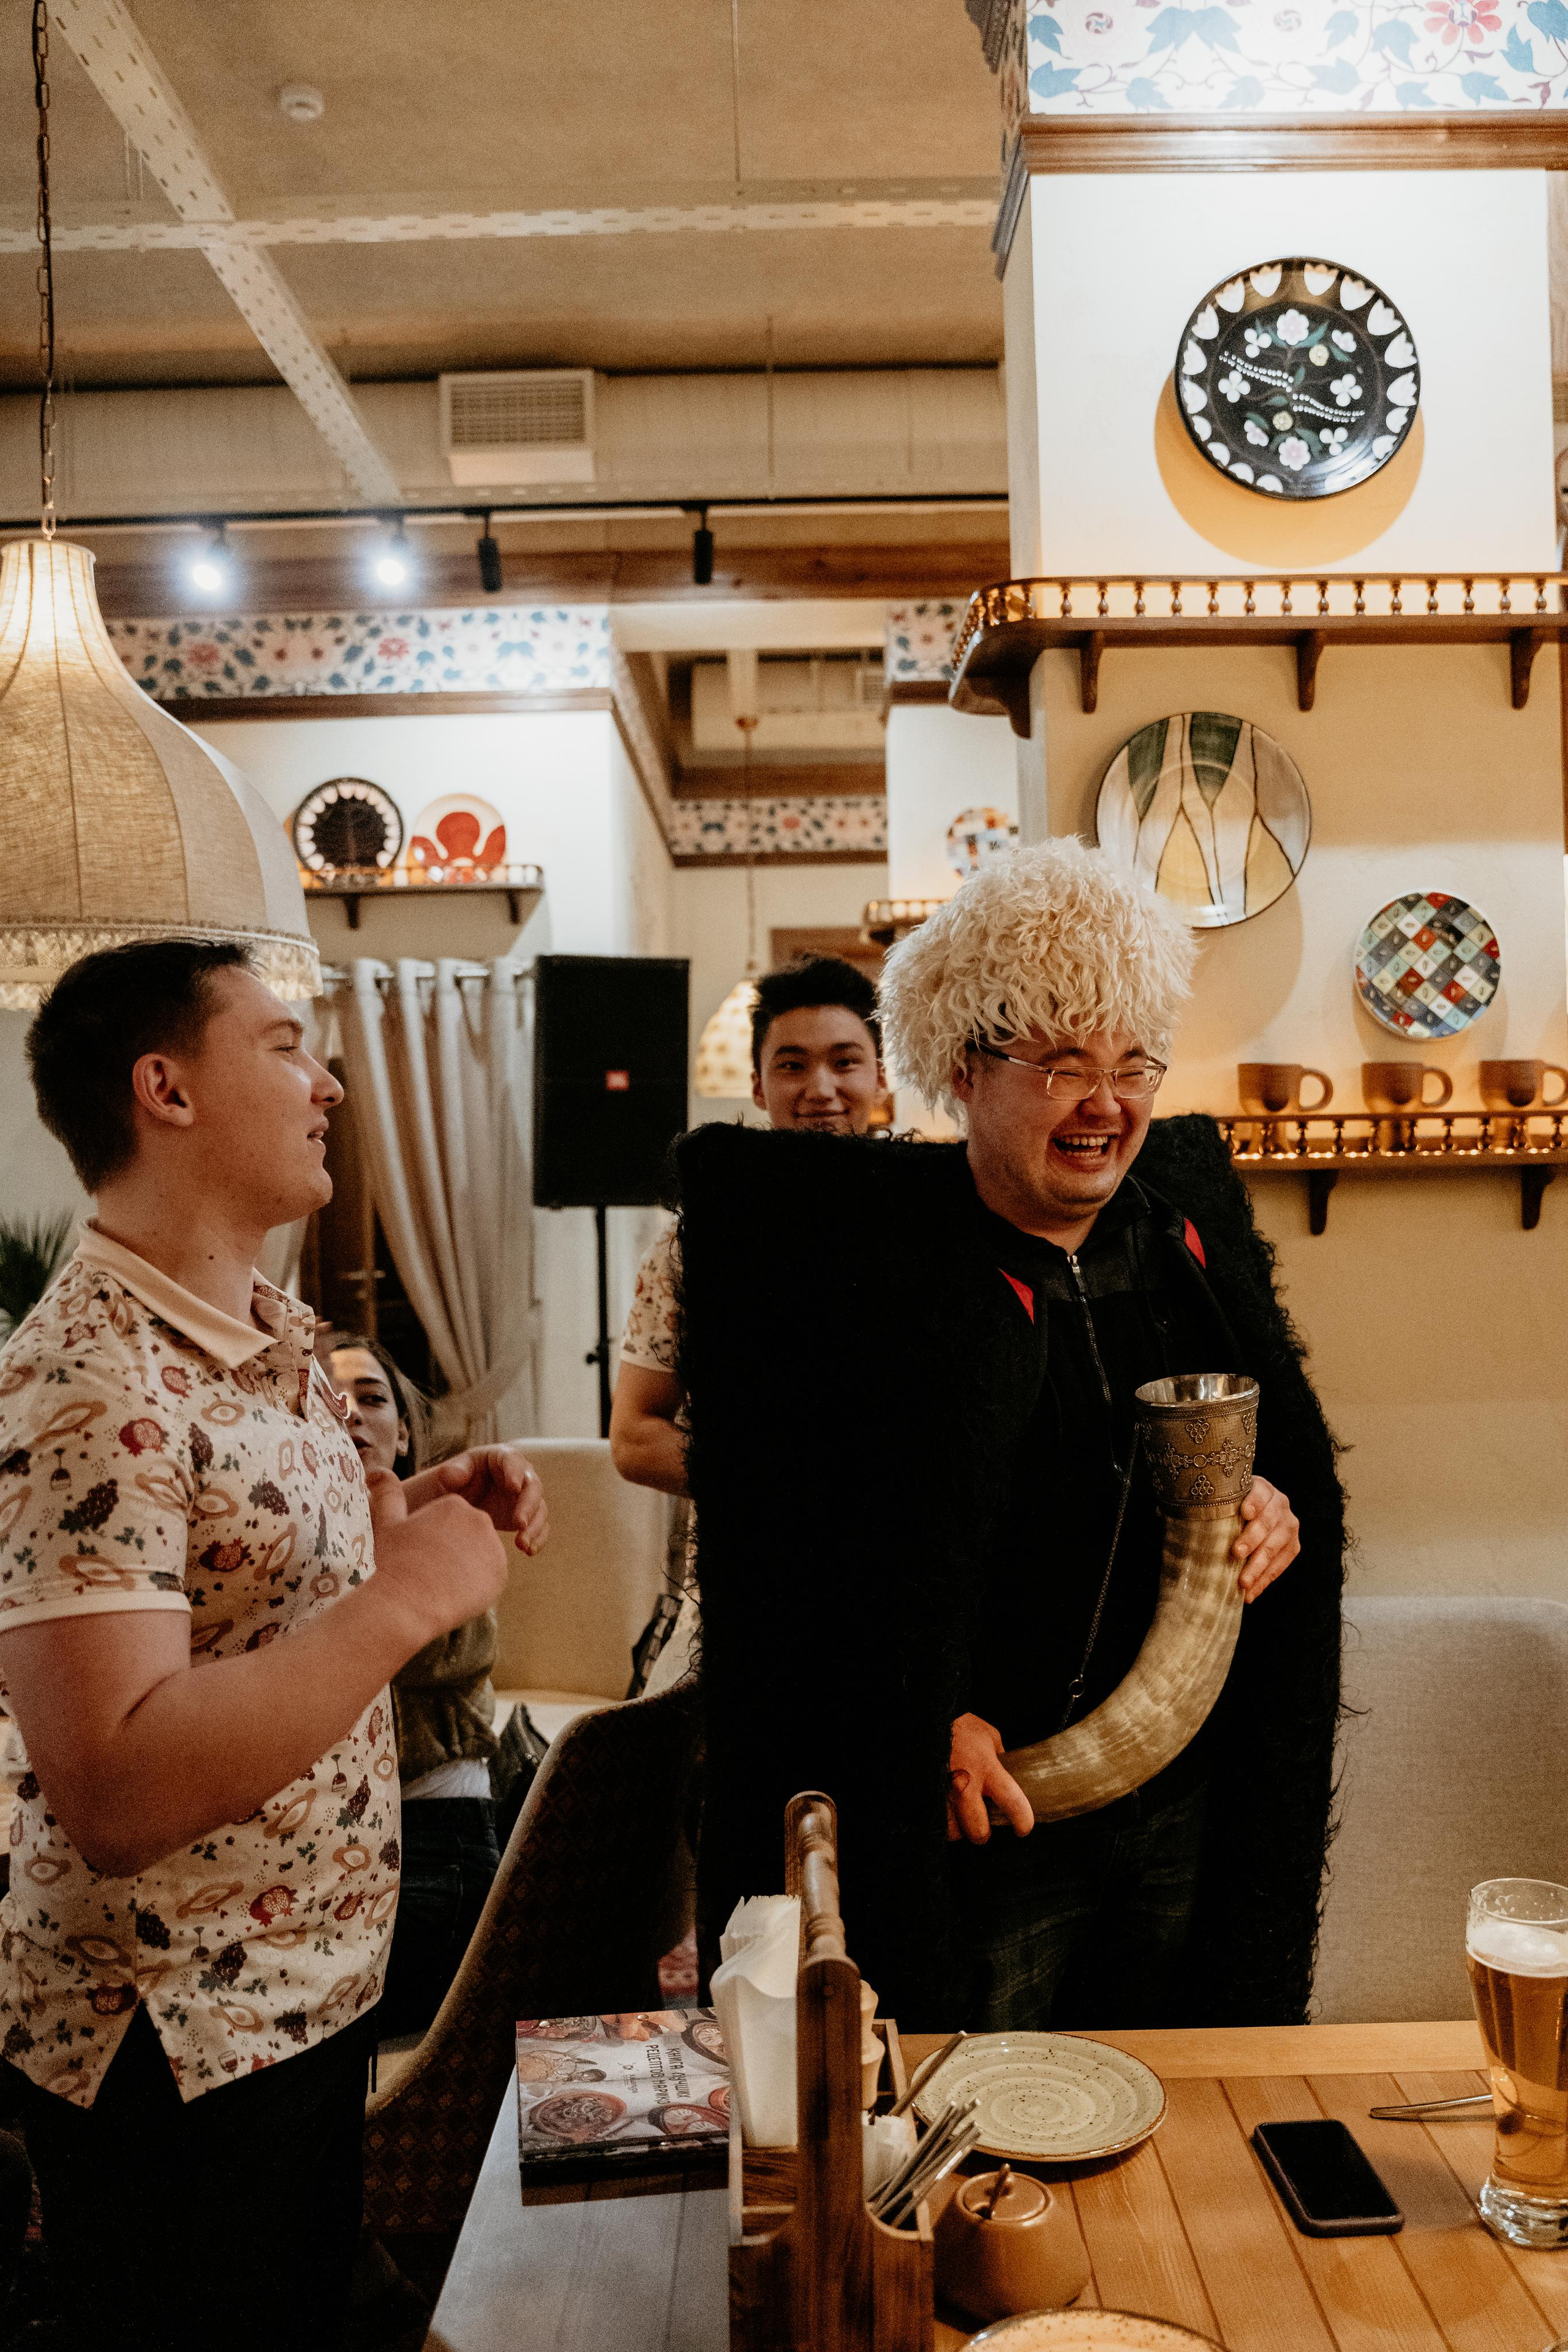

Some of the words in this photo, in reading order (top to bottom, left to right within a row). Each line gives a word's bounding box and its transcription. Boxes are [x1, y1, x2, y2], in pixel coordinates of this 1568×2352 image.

[646, 2045, 665, 2078] РЕЦЕПТОВ
[665, 2048, 684, 2070] КНИГА
[668, 2072, 691, 2098] ЛУЧШИХ
